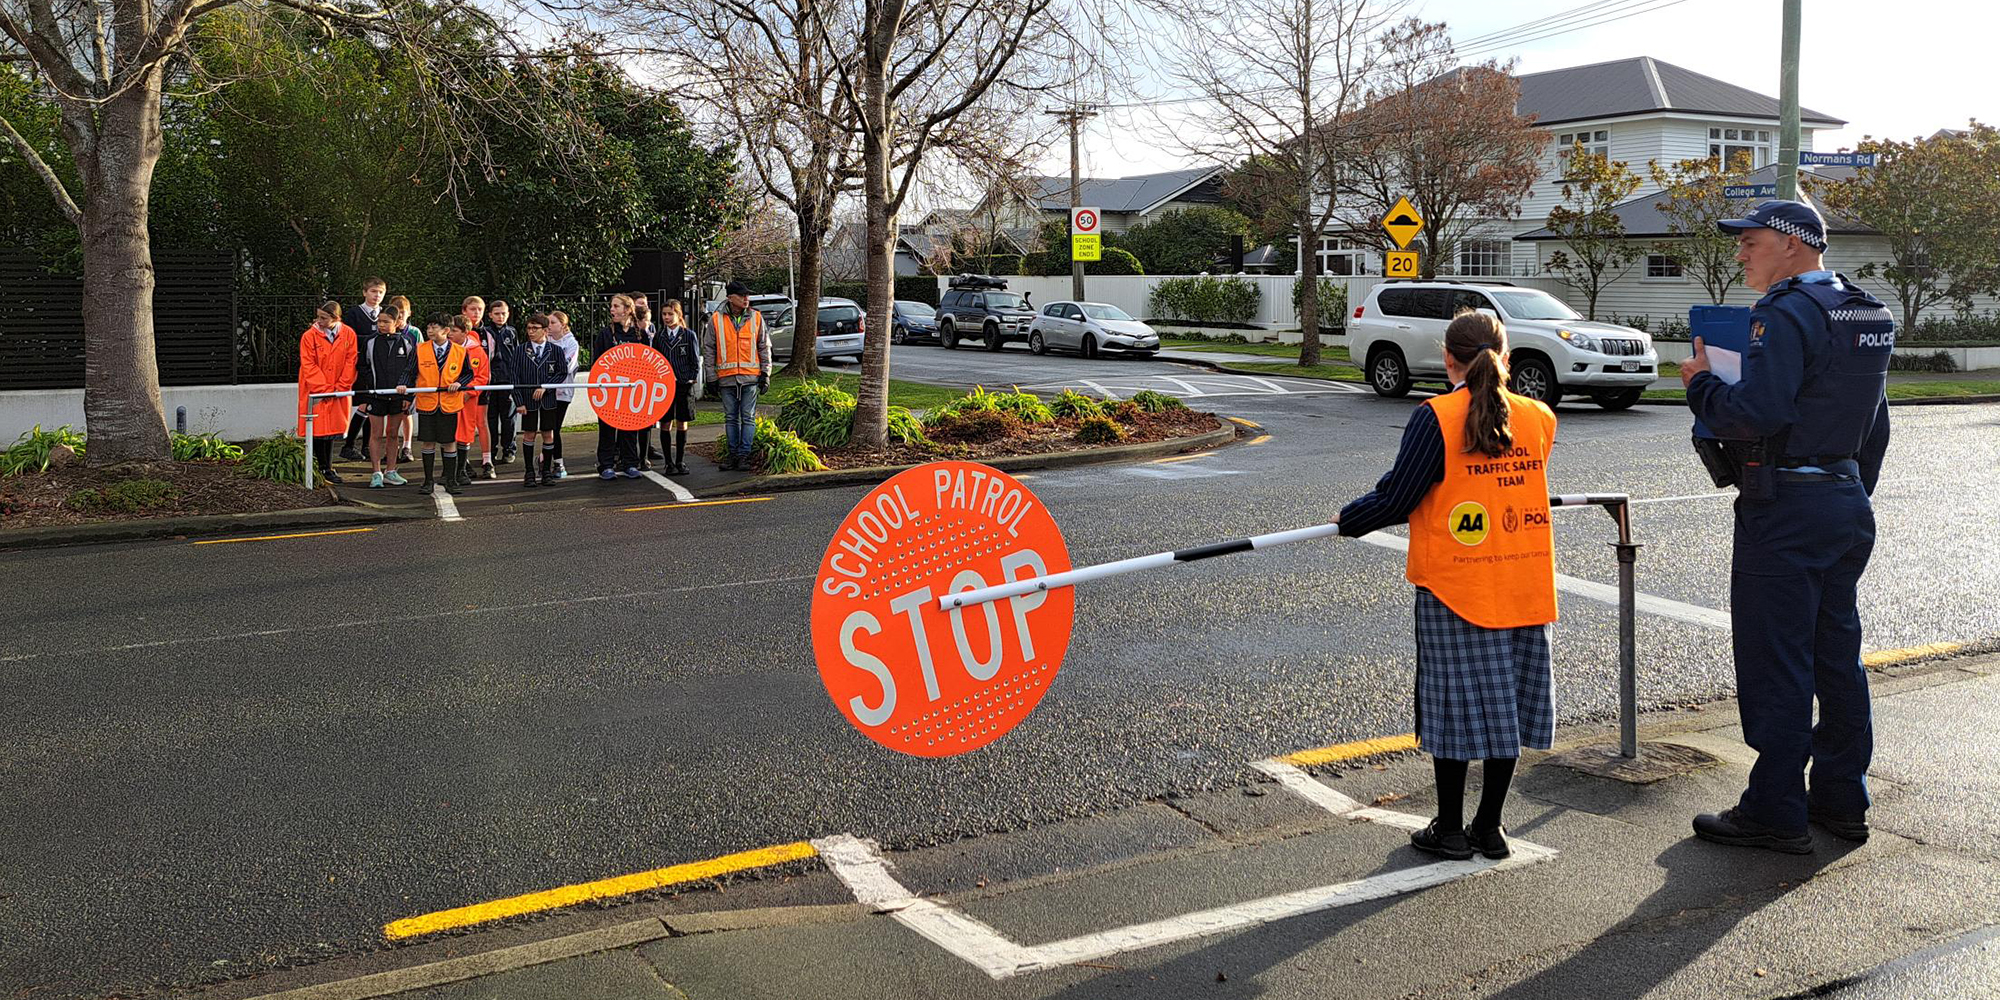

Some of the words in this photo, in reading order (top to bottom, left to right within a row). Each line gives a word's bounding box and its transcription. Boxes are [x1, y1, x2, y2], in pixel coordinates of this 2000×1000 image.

[1804, 153, 1852, 164] Normans
[1856, 154, 1871, 164] Rd
[1725, 187, 1755, 197] College
[1761, 186, 1776, 195] Ave
[1080, 216, 1093, 225] 50
[1392, 257, 1412, 272] 20
[1858, 332, 1895, 347] POLICE
[598, 346, 636, 370] SCHOOL
[641, 348, 671, 379] PATROL
[591, 372, 668, 416] STOP
[1488, 446, 1530, 459] HOOL
[1466, 462, 1511, 475] TRAFFIC
[1513, 460, 1543, 471] SAFET
[1497, 475, 1525, 487] TEAM
[1457, 513, 1483, 532] AA
[1524, 513, 1549, 525] POL
[822, 484, 920, 598] SCHOOL
[934, 469, 1033, 539] PATROL
[839, 549, 1048, 727] STOP
